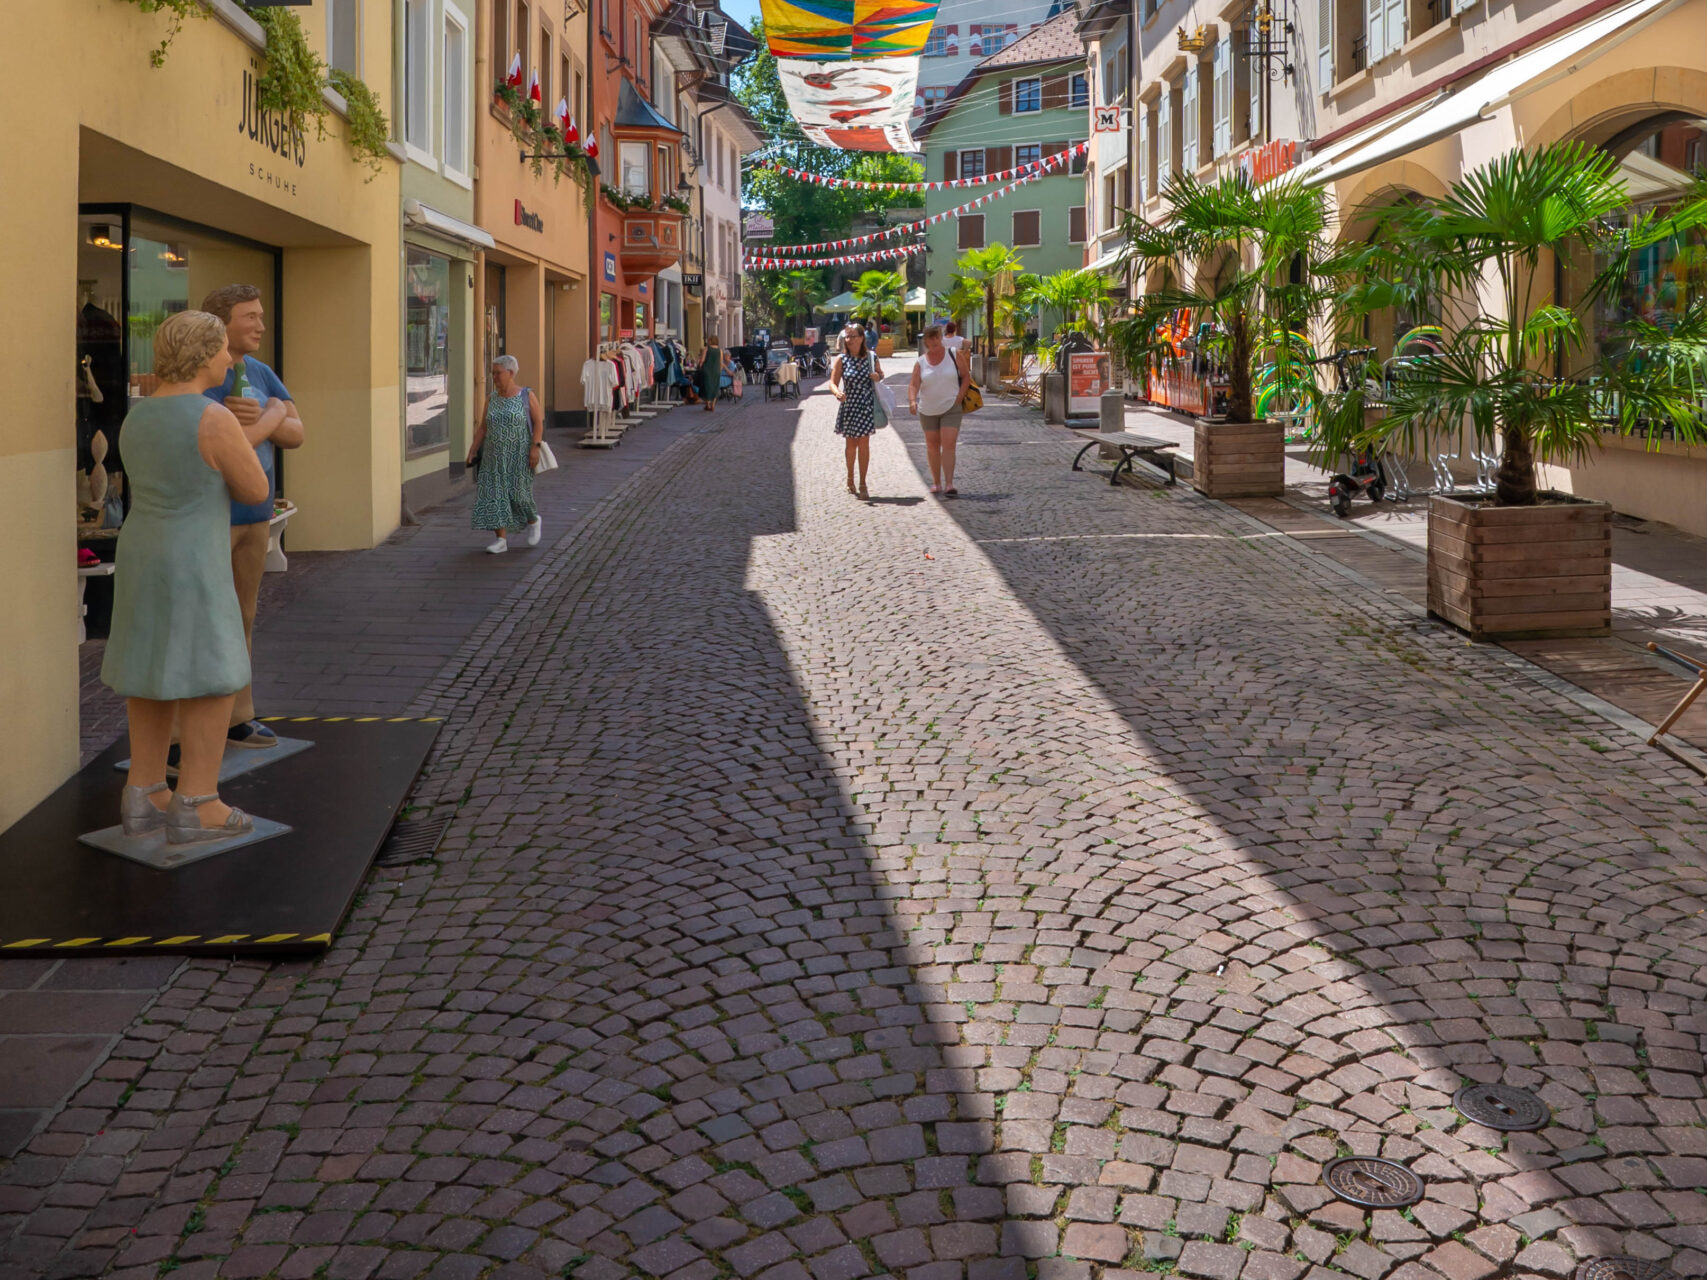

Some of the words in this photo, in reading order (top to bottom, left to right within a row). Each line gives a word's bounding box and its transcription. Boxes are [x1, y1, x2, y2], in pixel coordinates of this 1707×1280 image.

[238, 57, 306, 168] JÜRGENS
[1100, 114, 1114, 125] M
[249, 162, 297, 197] SCHUHE
[1252, 138, 1296, 185] Müller
